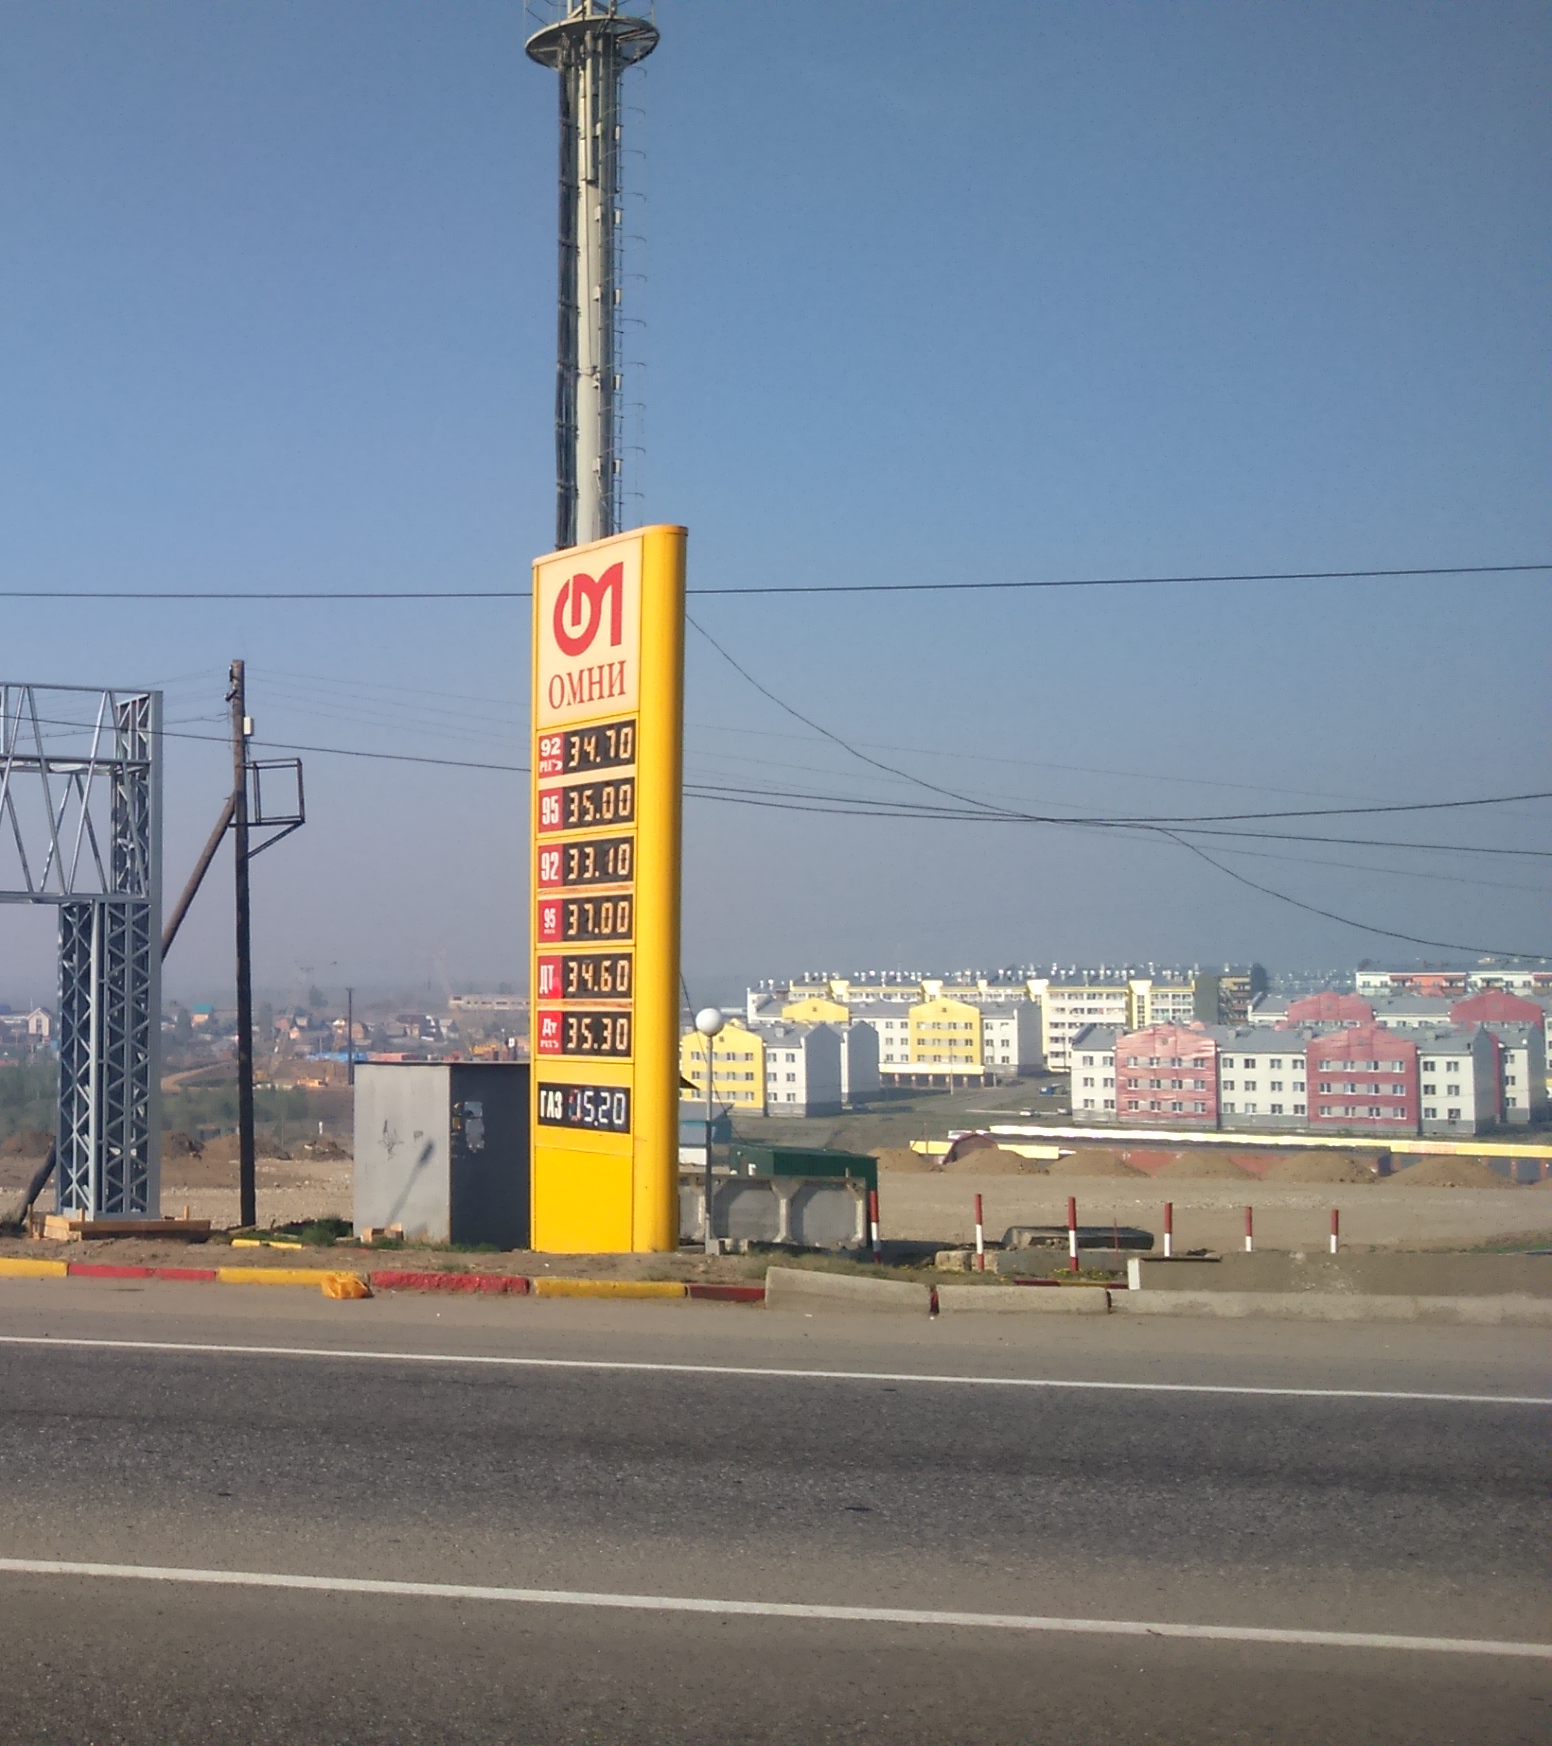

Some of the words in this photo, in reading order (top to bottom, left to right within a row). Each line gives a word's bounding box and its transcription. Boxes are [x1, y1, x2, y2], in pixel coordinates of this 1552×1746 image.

[548, 660, 627, 710] ОМНИ
[541, 737, 561, 757] 92
[542, 795, 559, 825] 95
[568, 784, 631, 822] 35.00
[541, 852, 559, 881] 92
[568, 843, 630, 879] 33.10
[544, 907, 556, 928] 95
[567, 901, 629, 935] 37.00
[539, 964, 554, 994] ДТ
[567, 960, 629, 992] 34.60
[567, 1017, 628, 1050] 35.30
[540, 1090, 563, 1119] ГАЗ
